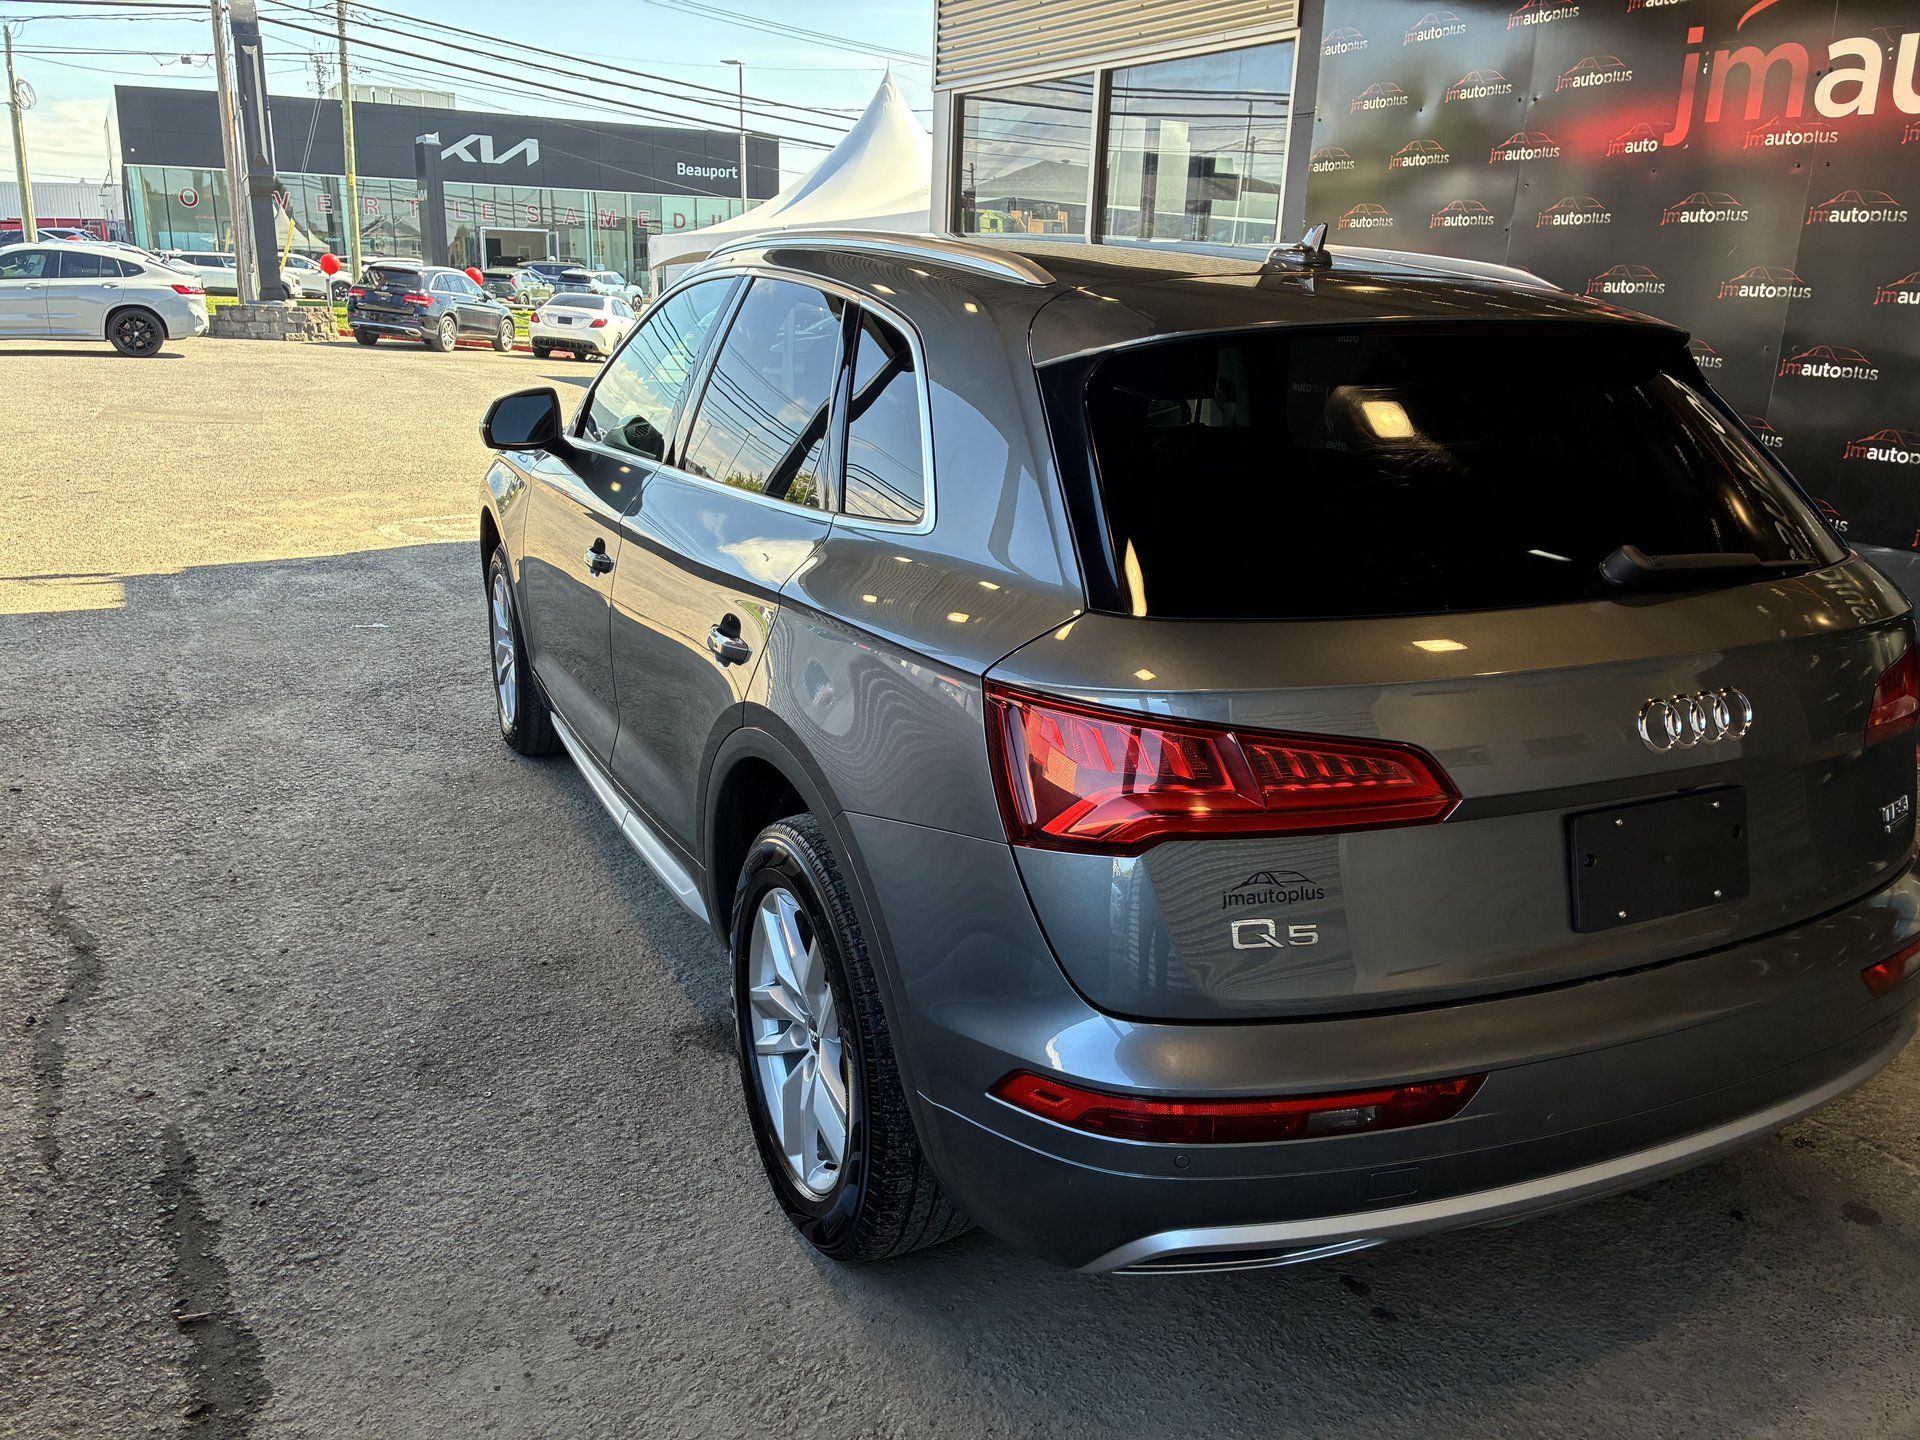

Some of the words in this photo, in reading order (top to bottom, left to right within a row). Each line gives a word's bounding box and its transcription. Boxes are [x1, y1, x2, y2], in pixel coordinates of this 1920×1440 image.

[1507, 5, 1579, 30] jmautoplus
[1556, 69, 1633, 91] jmautoplus
[1445, 83, 1512, 103] jmautoplus
[1743, 128, 1838, 149] jmautoplus
[441, 134, 539, 167] KIA
[1489, 145, 1560, 164] jmautoplus
[1389, 152, 1449, 170] jmautoplus
[677, 162, 738, 180] Beauport
[1337, 215, 1393, 230] jmautoplus
[1430, 213, 1494, 230] jmautoplus
[1536, 211, 1611, 229] jmautoplus
[1660, 208, 1749, 226] jmautoplus
[1806, 206, 1908, 225] jmautoplus
[1586, 278, 1665, 294] jmautoplus
[1718, 281, 1812, 300] jmautoplus
[1779, 360, 1878, 381] jmautoplus
[1222, 886, 1325, 909] jmautoplus
